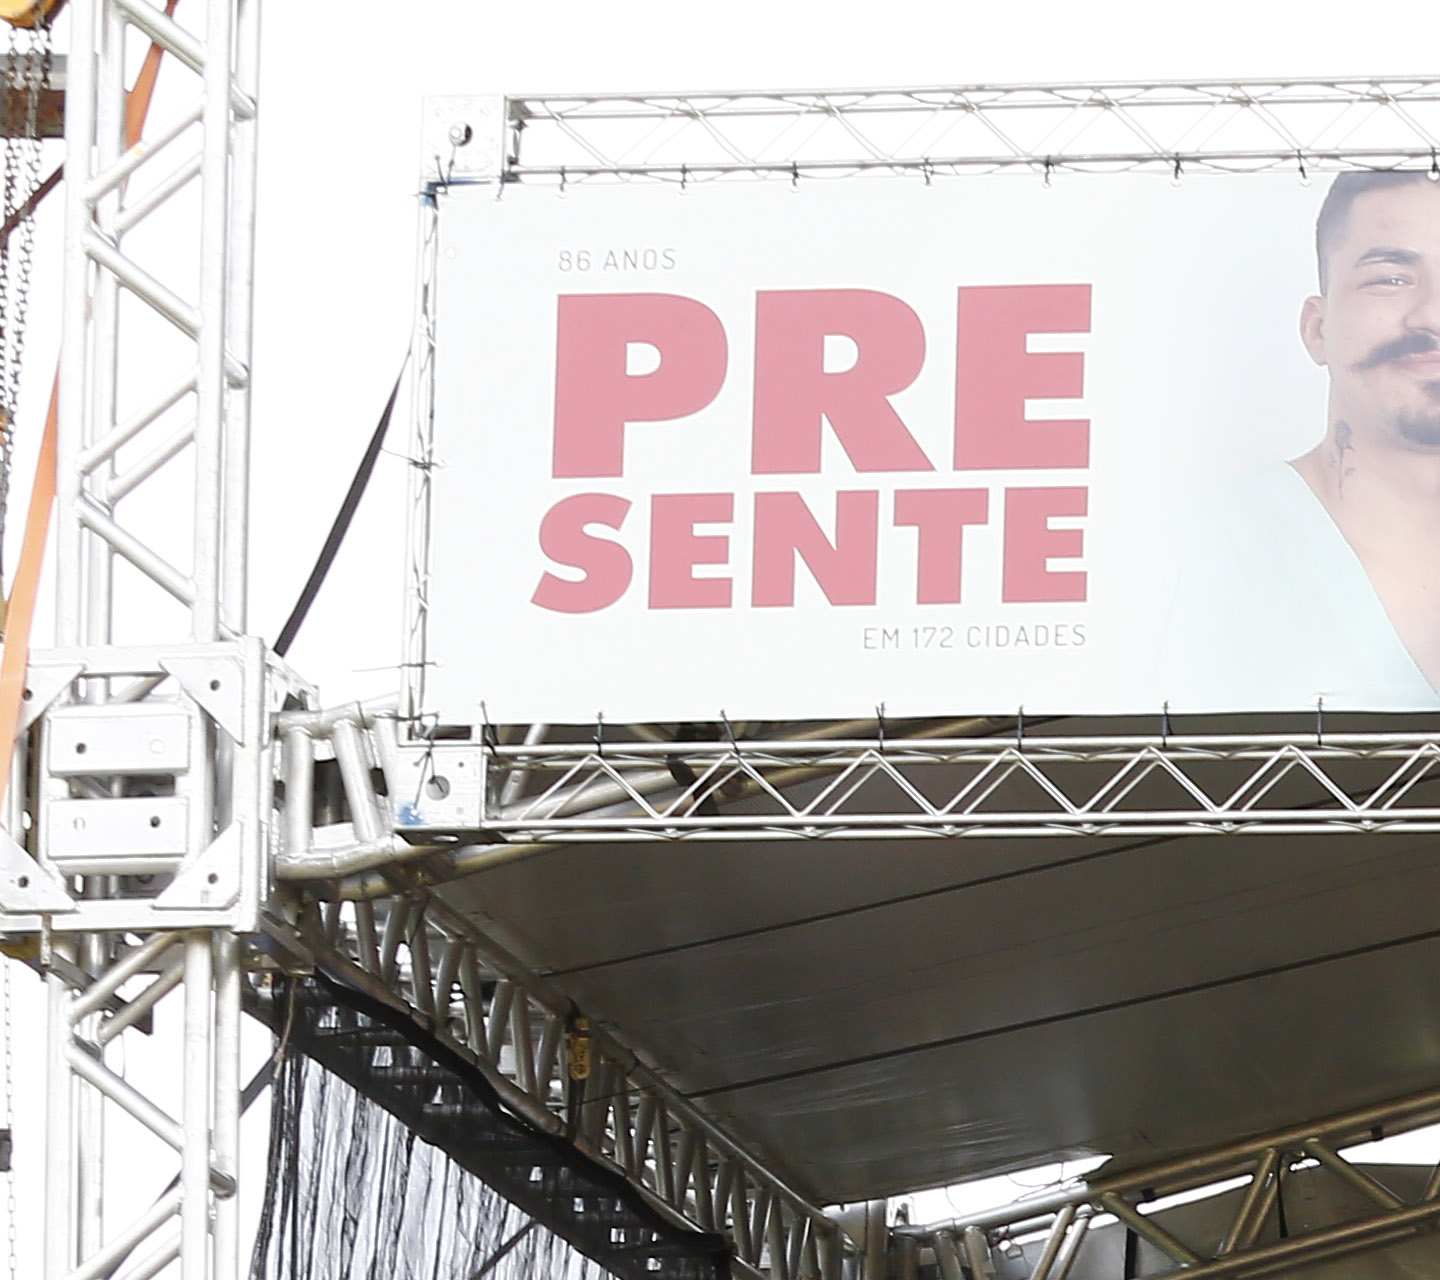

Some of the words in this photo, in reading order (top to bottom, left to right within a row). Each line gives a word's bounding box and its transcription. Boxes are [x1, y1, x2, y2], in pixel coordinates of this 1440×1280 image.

[558, 249, 592, 272] 86
[603, 247, 677, 271] ANOS
[552, 283, 1093, 480] PRE
[530, 485, 1089, 615] SENTE
[863, 627, 900, 650] EM
[913, 626, 954, 649] 172
[966, 624, 1087, 648] CIDADES
